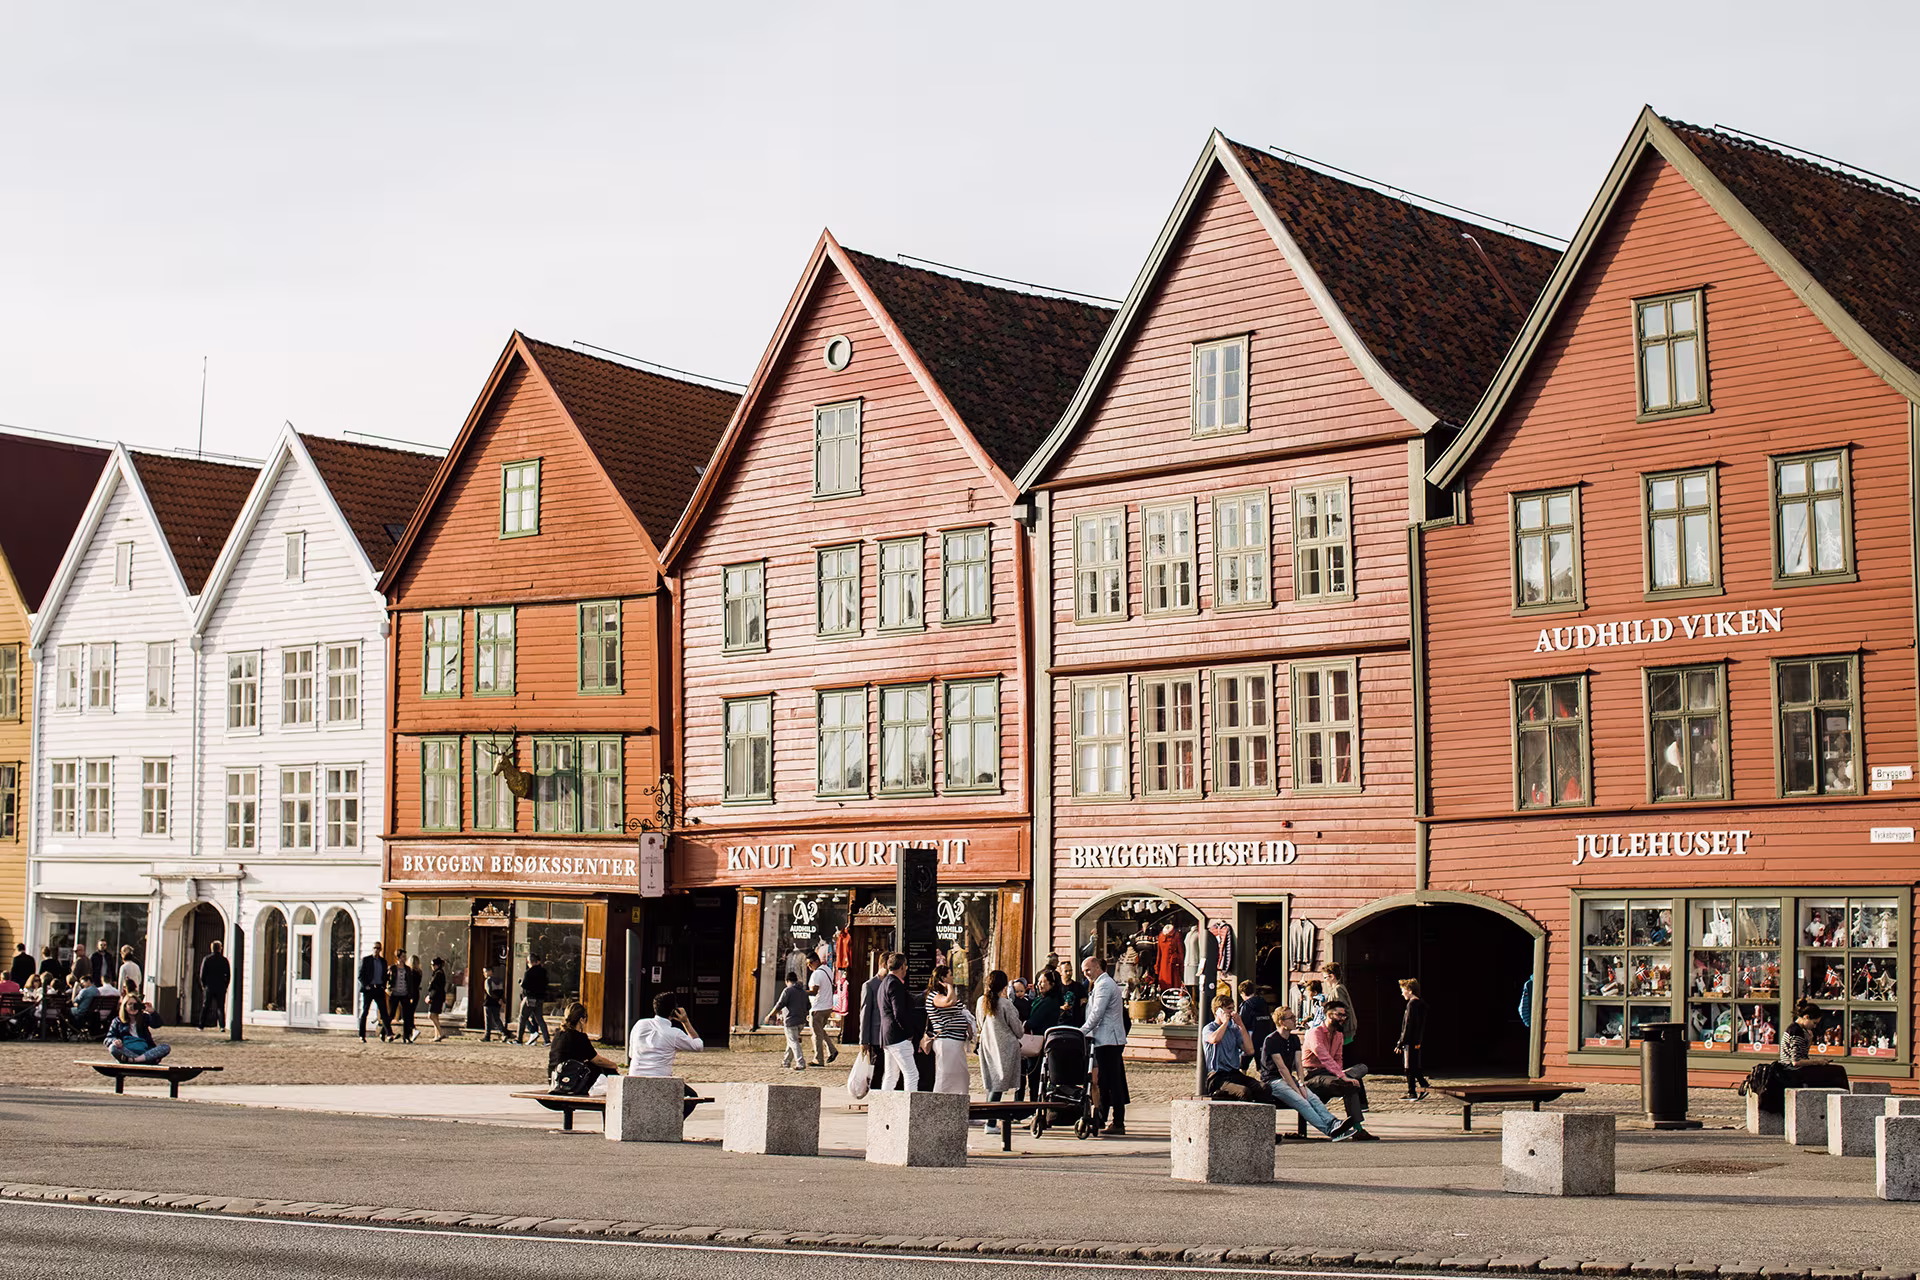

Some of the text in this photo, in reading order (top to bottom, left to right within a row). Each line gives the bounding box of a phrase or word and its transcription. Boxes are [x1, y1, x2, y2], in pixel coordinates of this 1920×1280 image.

[1534, 608, 1783, 652] AUDHILD VIKEN
[1877, 769, 1906, 779] Bryggen
[1874, 831, 1911, 840] Tyskebryggen
[728, 844, 796, 870] KNUT
[1070, 840, 1297, 868] BRYGGEN HUSFLID
[1572, 830, 1751, 865] JULEHUSET
[402, 855, 484, 873] BRYGGEN
[491, 855, 637, 876] BESØKSSENTER
[790, 925, 816, 933] AUDHILD
